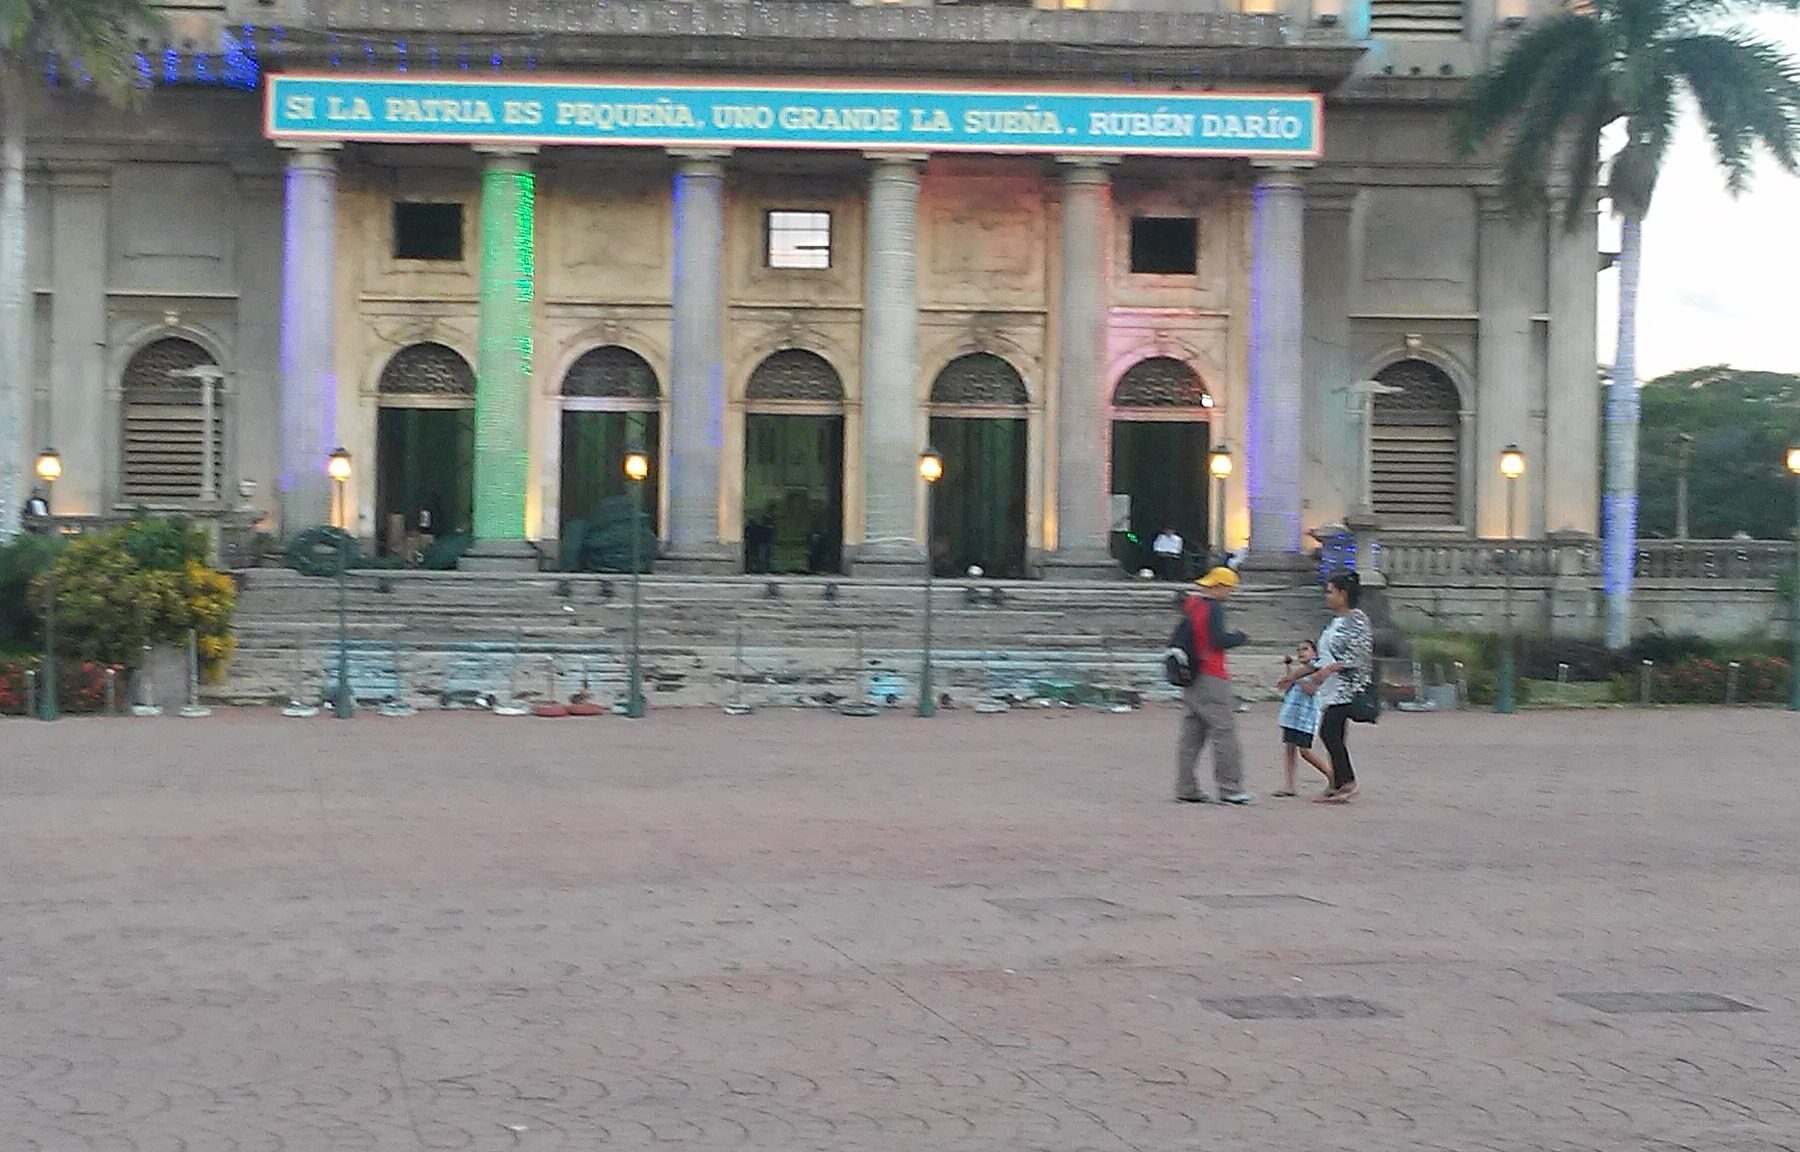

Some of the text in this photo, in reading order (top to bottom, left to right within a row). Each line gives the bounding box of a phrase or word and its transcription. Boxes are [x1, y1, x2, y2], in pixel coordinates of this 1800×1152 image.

[285, 94, 317, 123] SI
[326, 95, 374, 123] LA
[384, 97, 496, 126] PATRIA
[502, 100, 543, 126] ES
[711, 104, 775, 130] UNO
[778, 104, 900, 133] GRANDE
[910, 106, 955, 133] LA
[1087, 104, 1196, 138] RUBÉN
[1200, 106, 1304, 141] DARÍO
